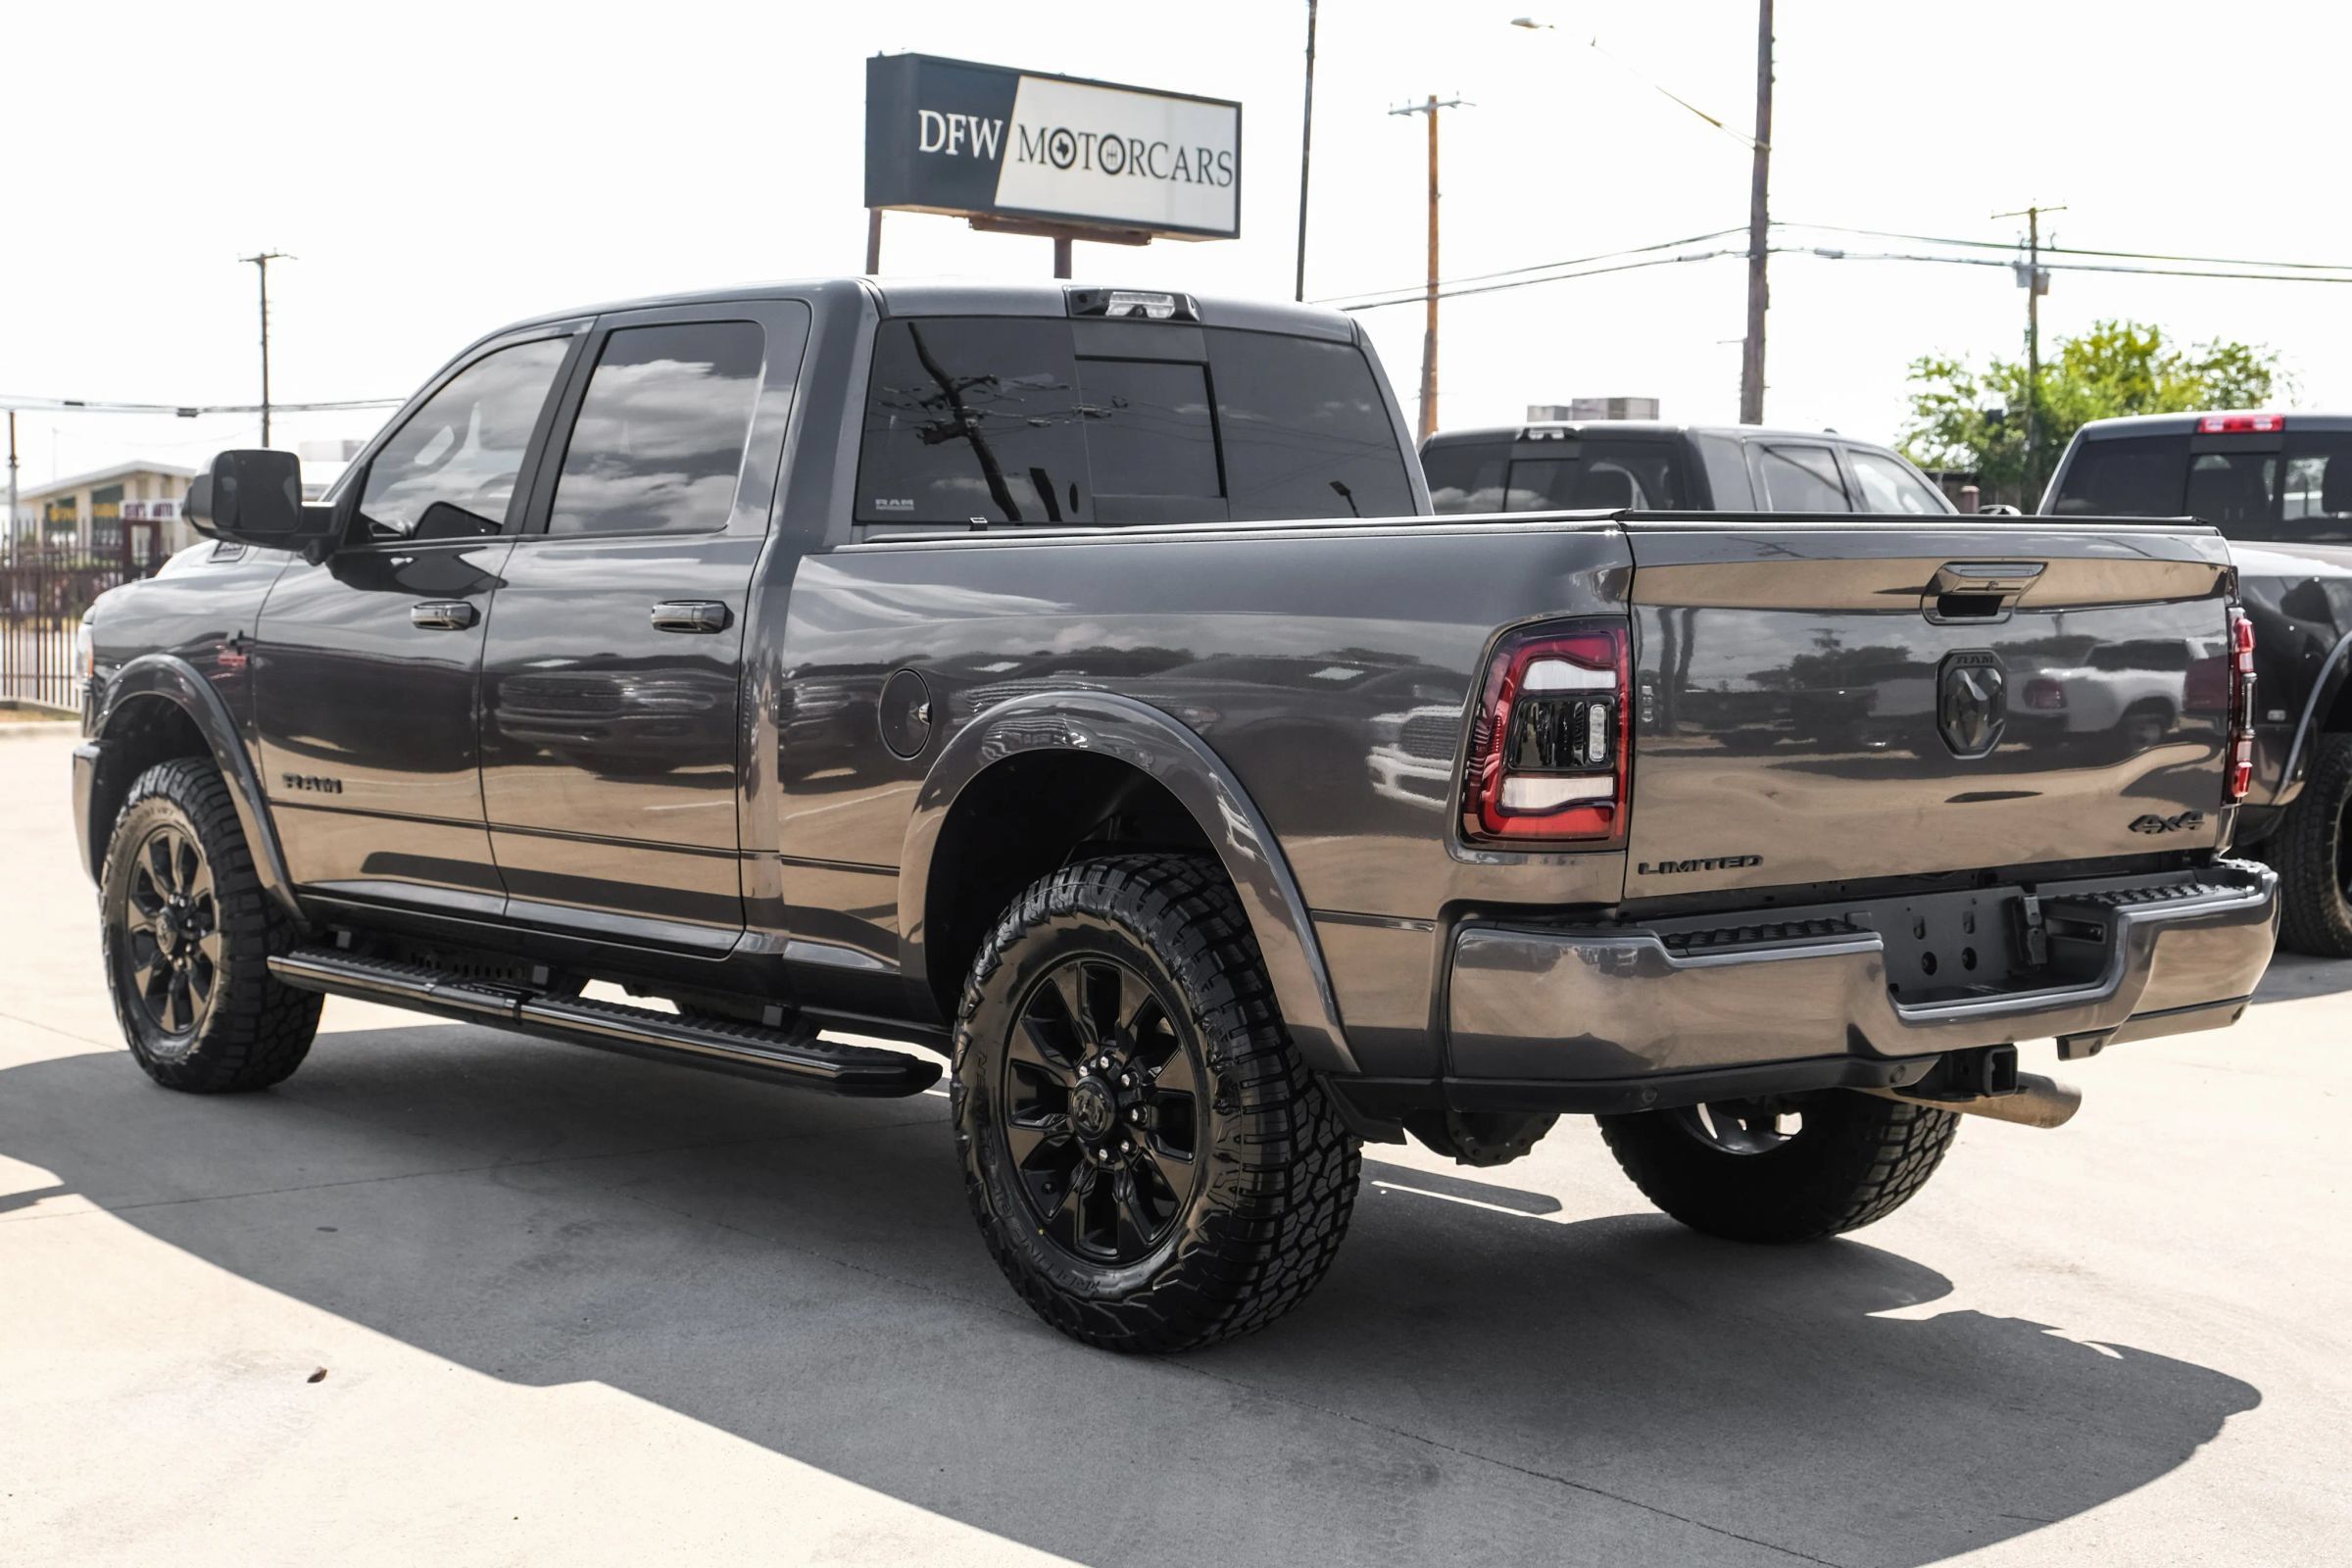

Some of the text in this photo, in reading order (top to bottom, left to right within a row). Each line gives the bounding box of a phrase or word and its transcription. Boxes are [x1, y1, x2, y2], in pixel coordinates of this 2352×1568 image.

[917, 108, 1235, 188] DFW MOTORCARS
[1955, 655, 1995, 664] RAM
[281, 772, 343, 794] RAM
[1638, 855, 1764, 875] LIMITED
